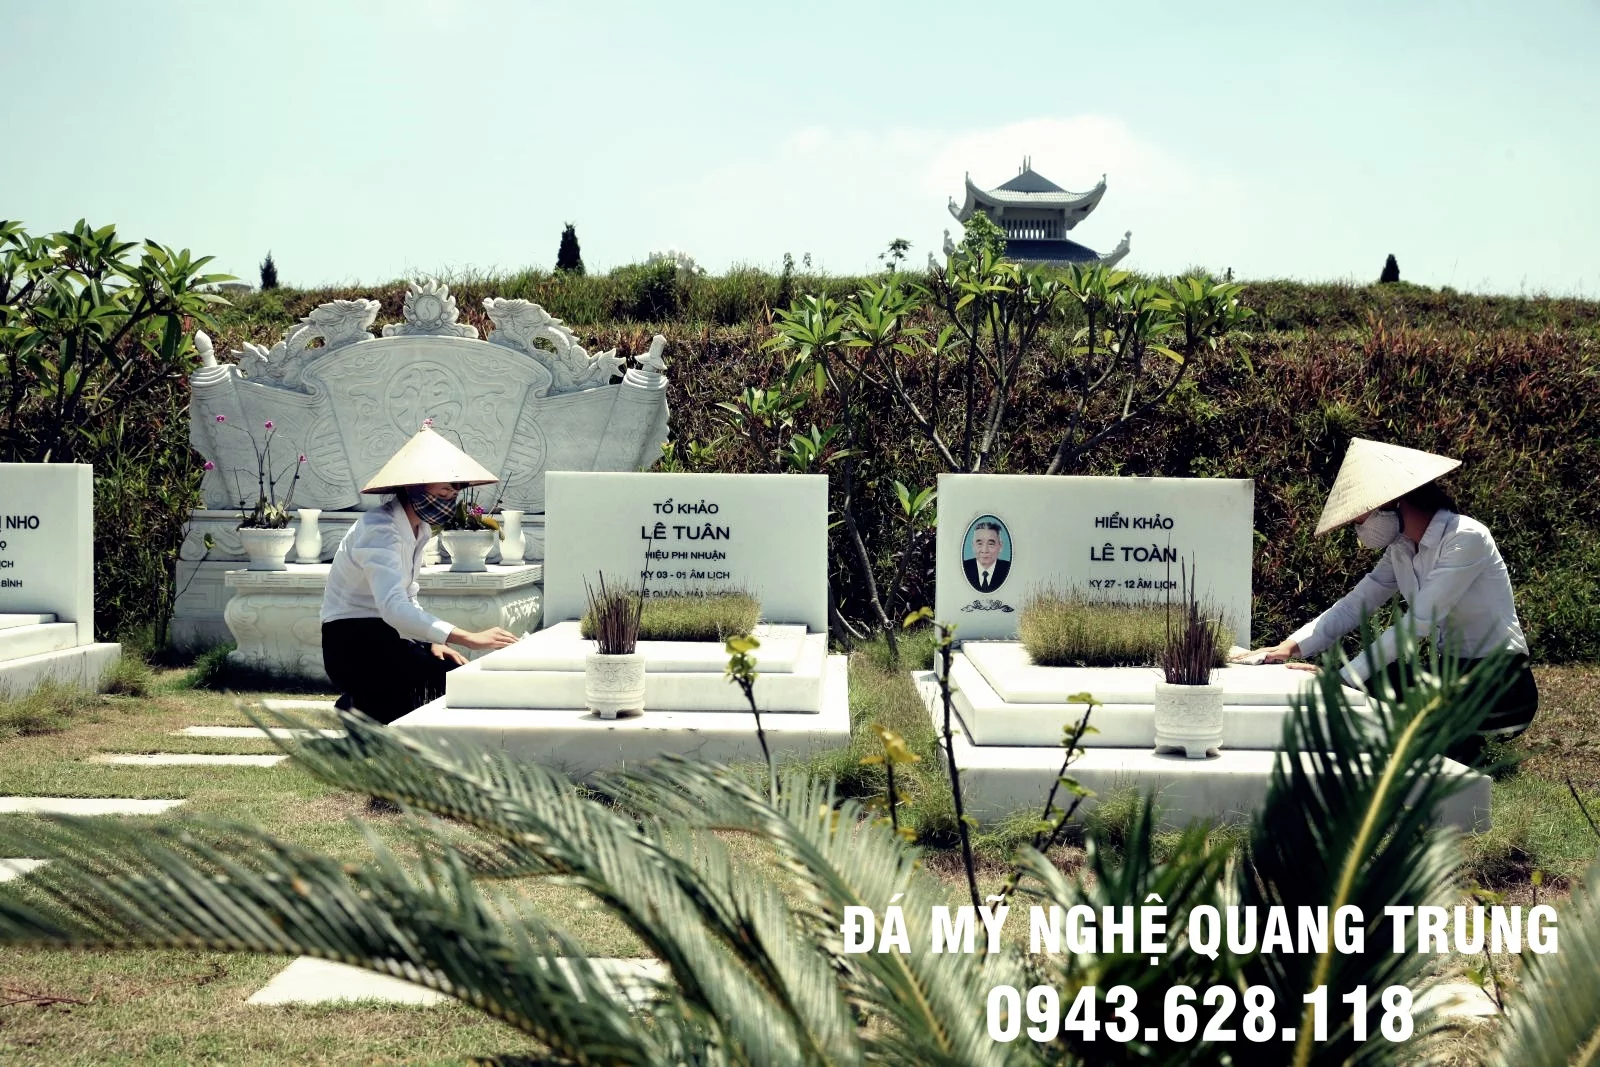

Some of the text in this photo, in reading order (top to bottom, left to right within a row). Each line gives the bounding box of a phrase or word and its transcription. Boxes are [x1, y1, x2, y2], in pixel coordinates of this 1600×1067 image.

[653, 498, 719, 514] TỔ KHẢO
[6, 515, 40, 529] NHO
[1095, 512, 1174, 530] HIỂN KHẢO
[641, 522, 730, 540] LÊ TUÂN
[645, 549, 726, 562] HIỆU PHI NHUẬN
[1090, 543, 1177, 562] LÊ TOÀN
[0, 560, 14, 569] CH
[656, 571, 668, 579] 03
[689, 569, 705, 579] ÂM
[707, 571, 730, 581] LỊCH
[1, 578, 23, 588] BÌNH
[1104, 579, 1116, 588] 27
[1124, 580, 1135, 589] 12
[1136, 577, 1152, 589] ÂM
[1154, 580, 1177, 592] LỊCH
